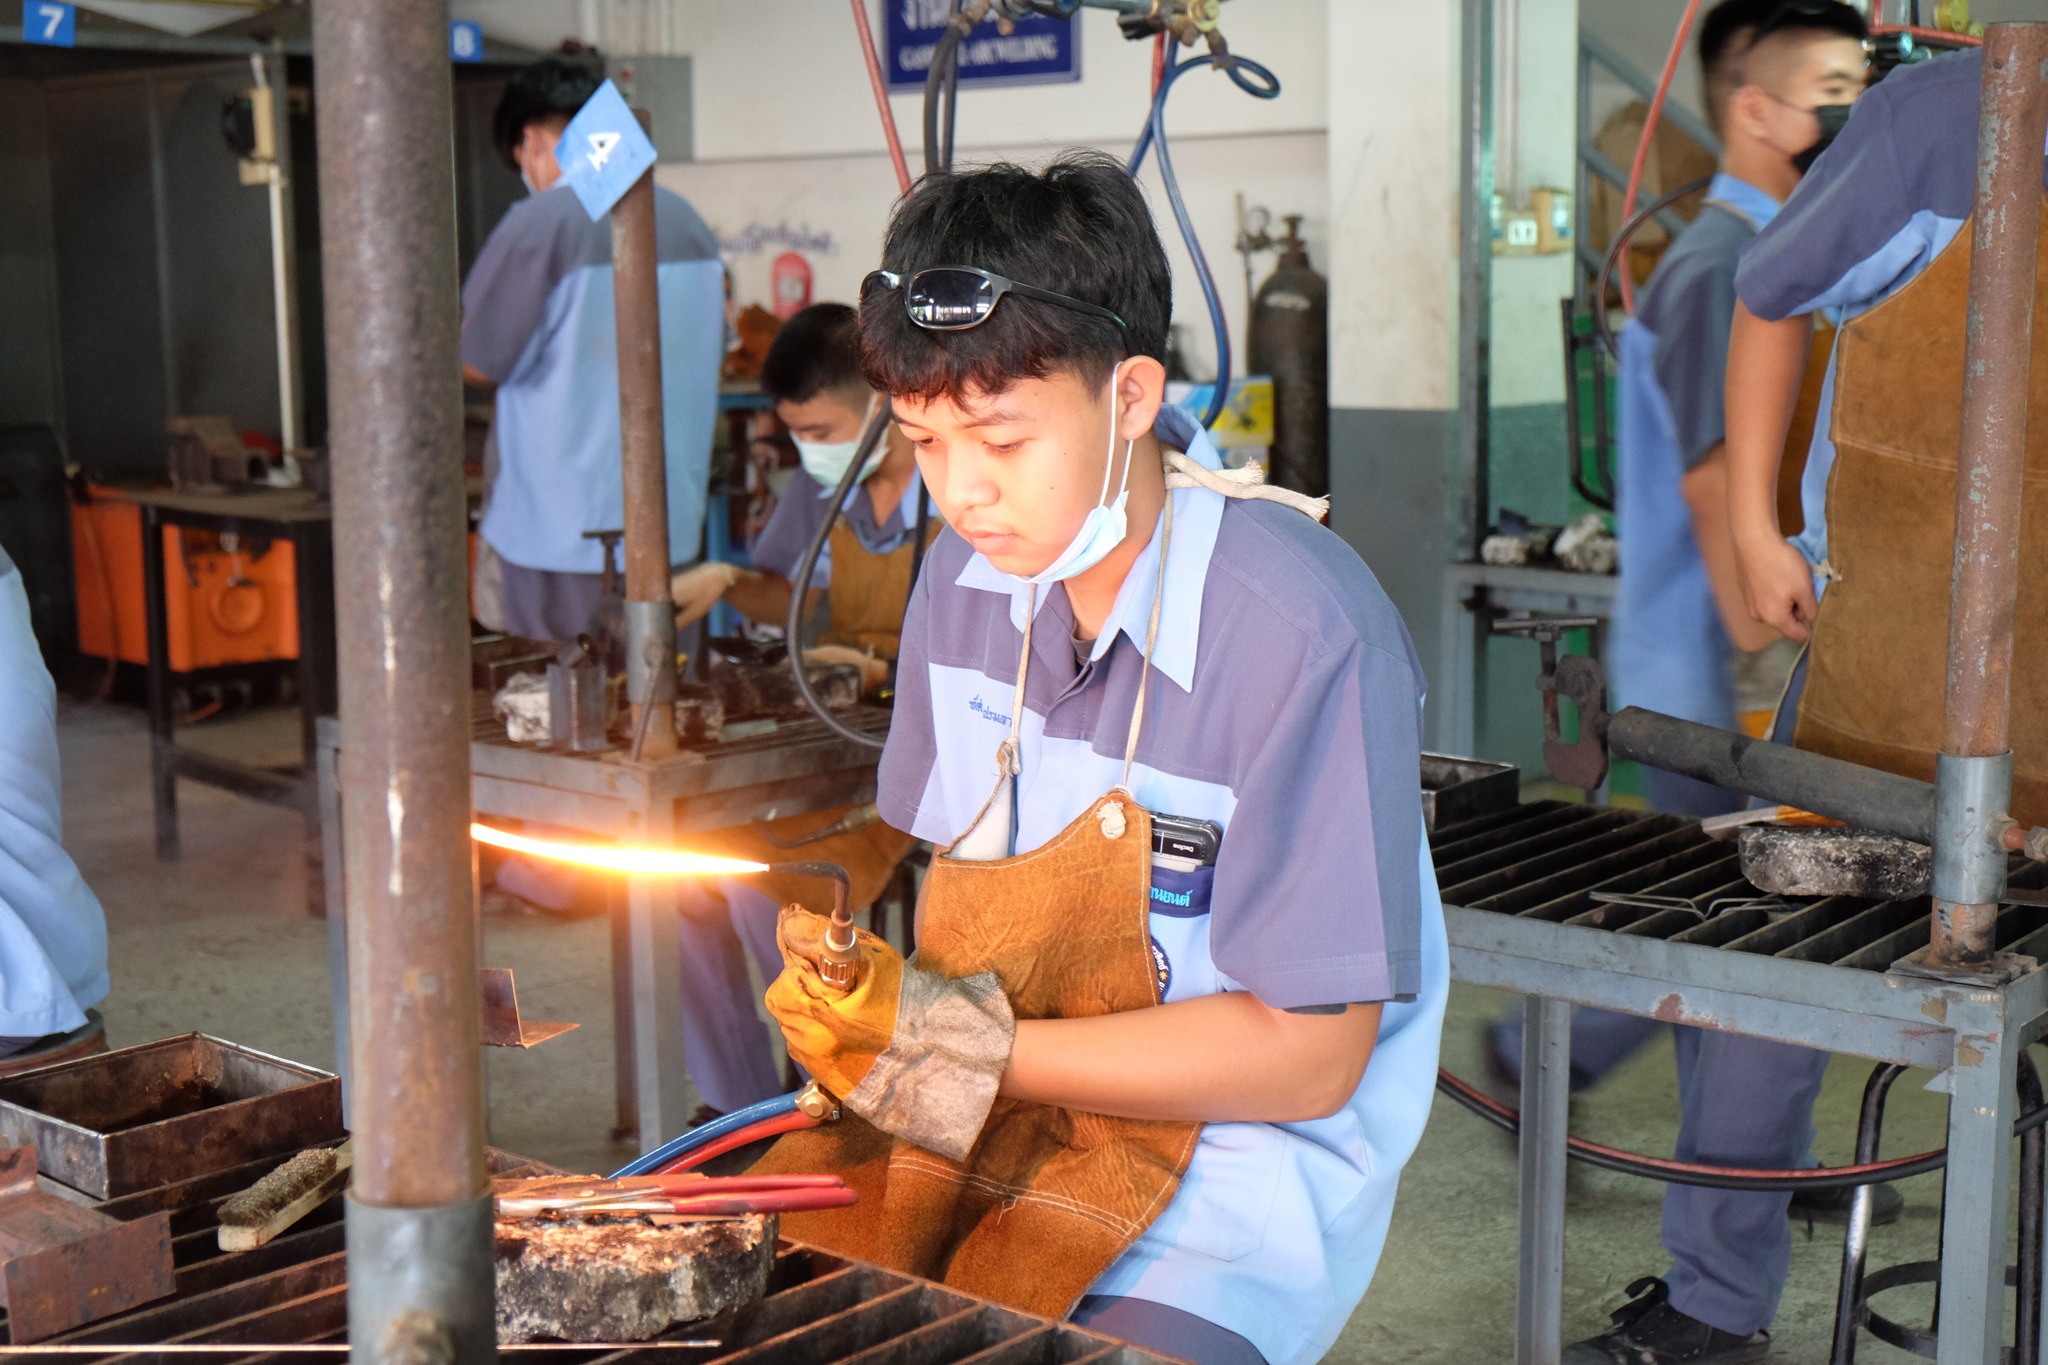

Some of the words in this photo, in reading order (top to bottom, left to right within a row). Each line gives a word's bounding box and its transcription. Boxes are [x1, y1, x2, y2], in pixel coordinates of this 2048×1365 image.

[40, 4, 65, 39] 7
[586, 131, 621, 172] 4
[1150, 886, 1193, 907] านยนต์
